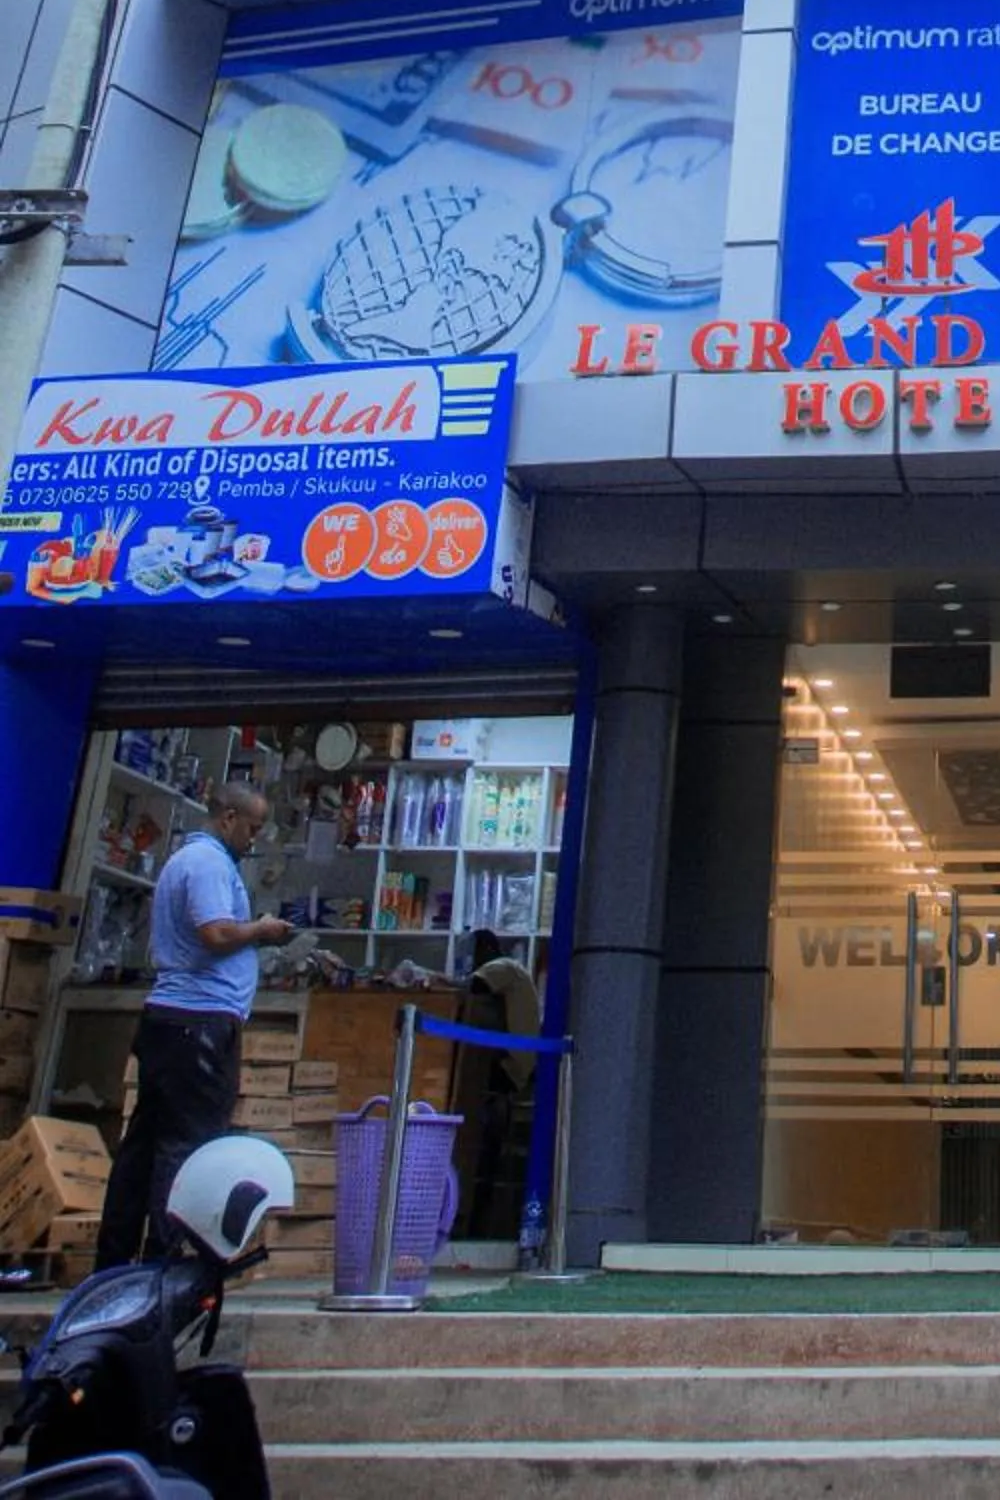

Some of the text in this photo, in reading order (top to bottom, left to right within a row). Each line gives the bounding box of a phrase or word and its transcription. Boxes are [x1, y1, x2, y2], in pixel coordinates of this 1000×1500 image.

[811, 25, 960, 56] optimum
[859, 91, 982, 116] BUREAU
[831, 134, 873, 156] DE
[570, 323, 663, 376] LE
[689, 314, 986, 373] GRAND
[36, 381, 417, 448] Kwa Dullah
[8, 446, 396, 482] ers: All Kind of Disposal items.
[116, 483, 152, 502] 550
[157, 481, 194, 500] 729
[218, 478, 285, 498] Pemba
[304, 475, 377, 496] Skukuu
[399, 471, 488, 492] Kariakoo
[323, 513, 361, 533] WE
[431, 512, 481, 532] deliver
